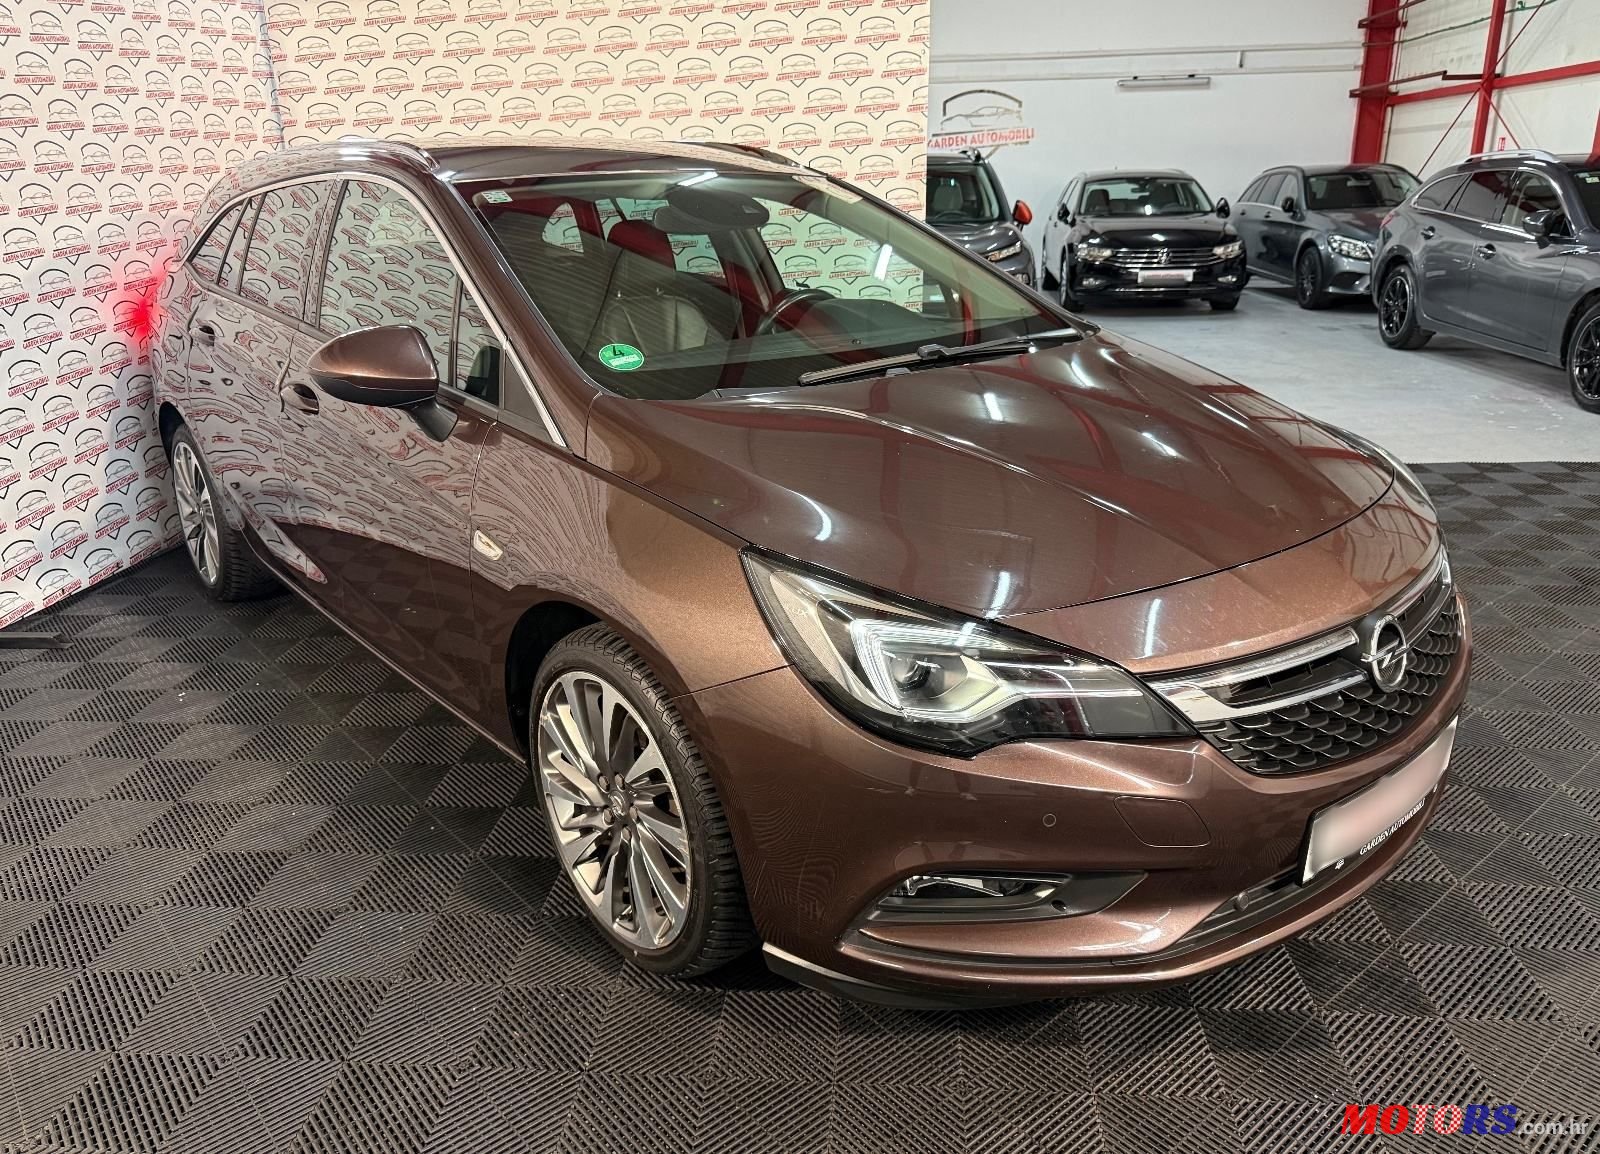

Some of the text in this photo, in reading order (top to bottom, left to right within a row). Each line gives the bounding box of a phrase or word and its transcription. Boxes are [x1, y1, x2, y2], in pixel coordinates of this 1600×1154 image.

[928, 128, 1035, 149] GARDEN AUTOMOBILI
[612, 345, 625, 356] 4
